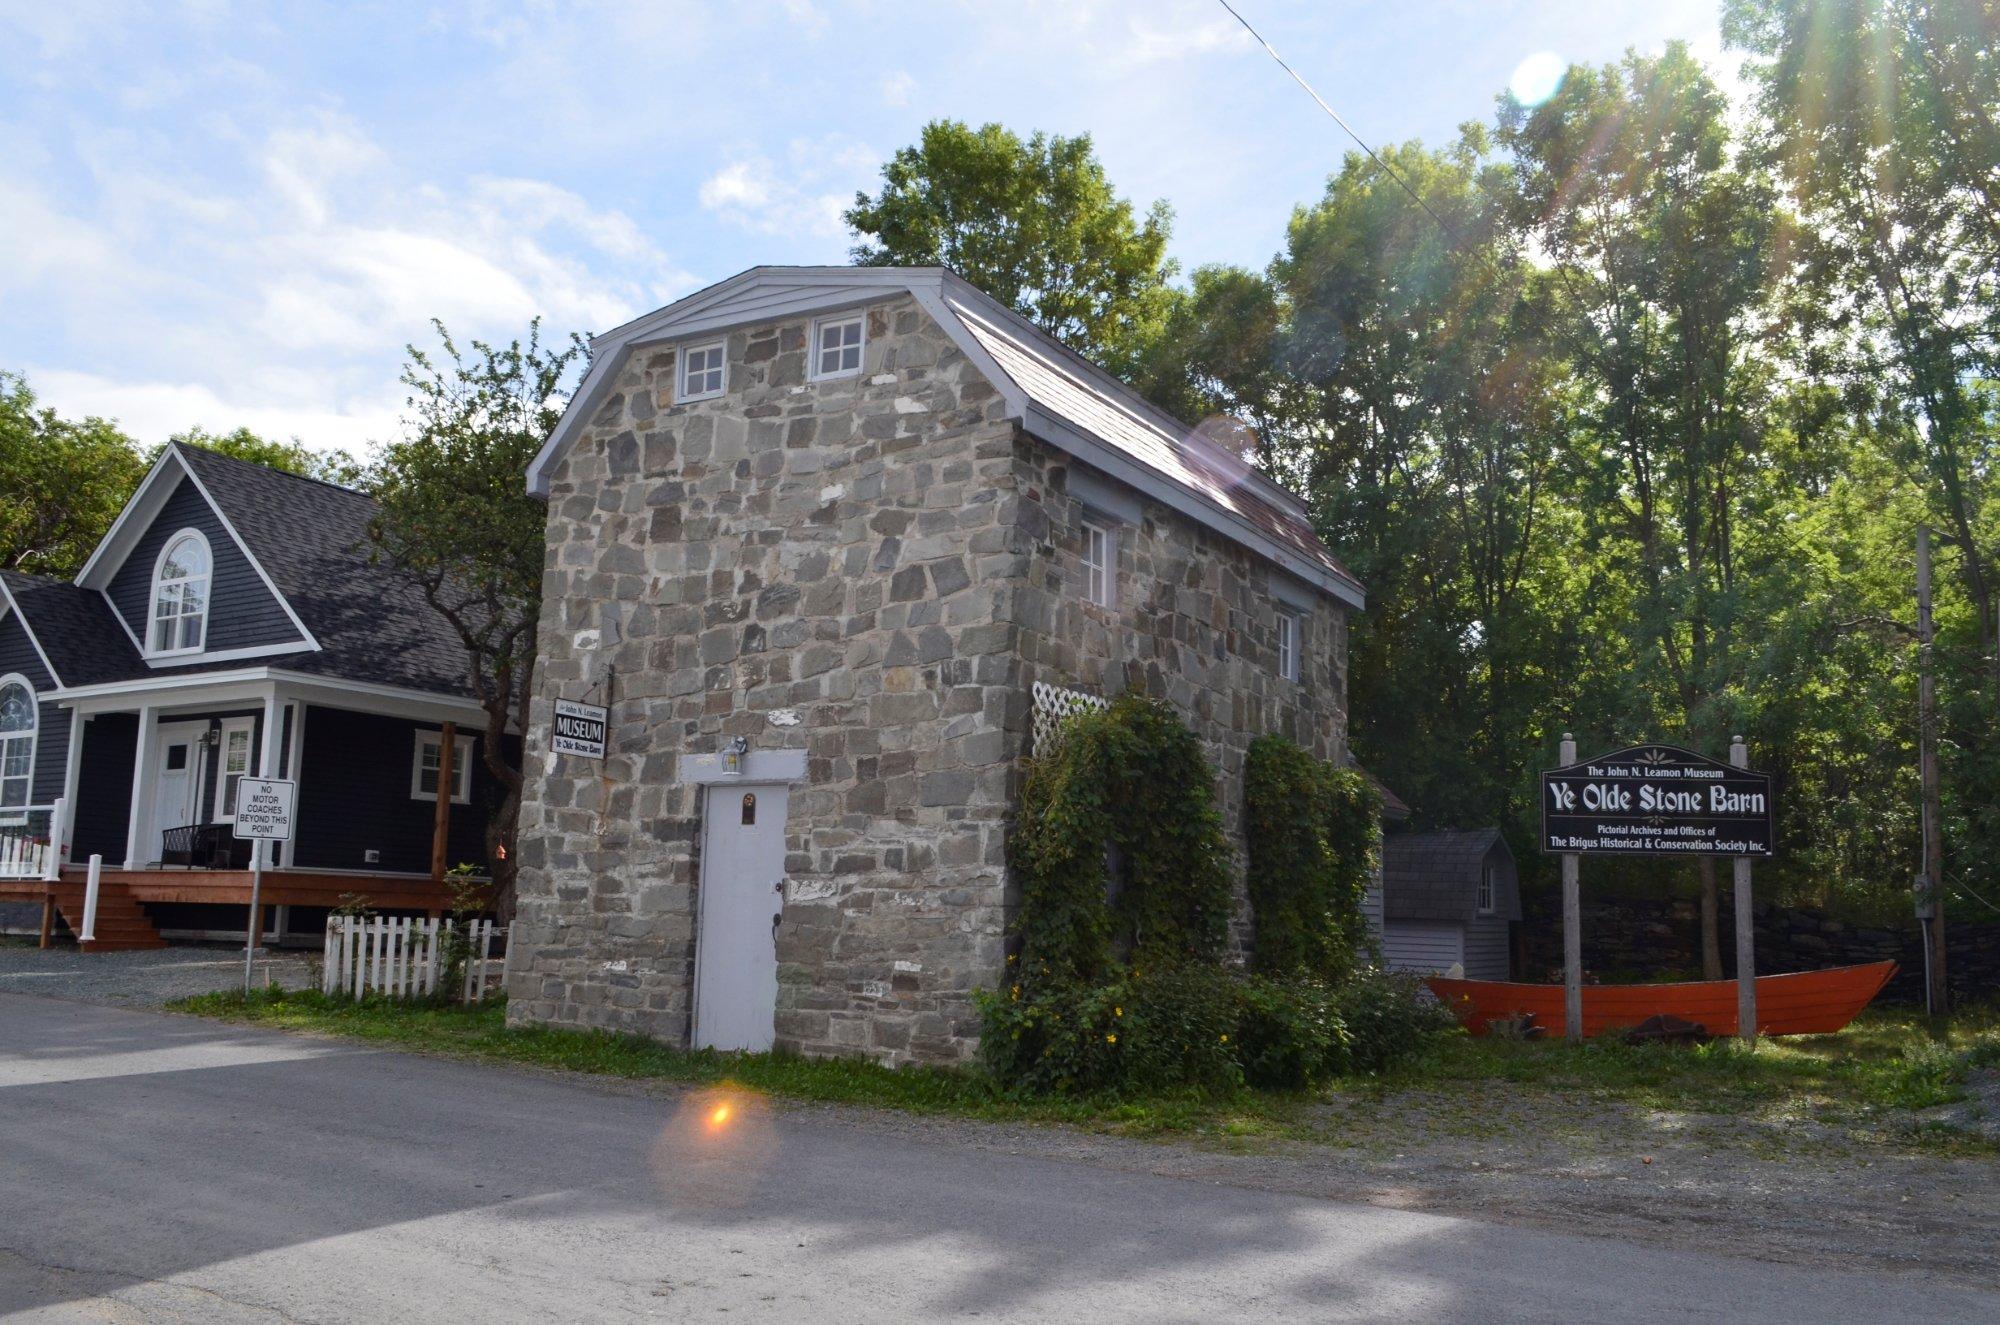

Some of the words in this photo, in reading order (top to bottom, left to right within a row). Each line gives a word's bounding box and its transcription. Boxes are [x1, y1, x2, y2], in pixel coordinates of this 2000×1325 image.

[557, 717, 601, 740] MUSEUM
[1588, 766, 1604, 776] The
[1608, 767, 1628, 776] John
[1632, 767, 1641, 776] N.
[1645, 768, 1681, 777] Leamon
[1684, 769, 1724, 778] Museum
[253, 795, 278, 804] MOTOR
[1550, 782, 1576, 810] Ye
[1583, 783, 1631, 811] Olde
[1639, 784, 1702, 812] Stone
[1710, 785, 1765, 813] Barn
[247, 805, 282, 814] COACHES
[240, 814, 269, 823] BEYOND
[272, 816, 287, 824] THIS
[252, 825, 273, 833] POINT
[1598, 825, 1628, 834] Pictorial
[1630, 826, 1662, 835] Archives
[1664, 827, 1678, 835] and
[1680, 827, 1705, 835] Offices
[1708, 827, 1715, 836] of
[1551, 837, 1567, 847] The
[1569, 837, 1597, 849] Brigus
[1600, 838, 1642, 848] Historical
[1645, 839, 1653, 848] &
[1655, 839, 1713, 849] Conservation
[1715, 840, 1747, 852] Society
[1750, 841, 1765, 851] Inc.
